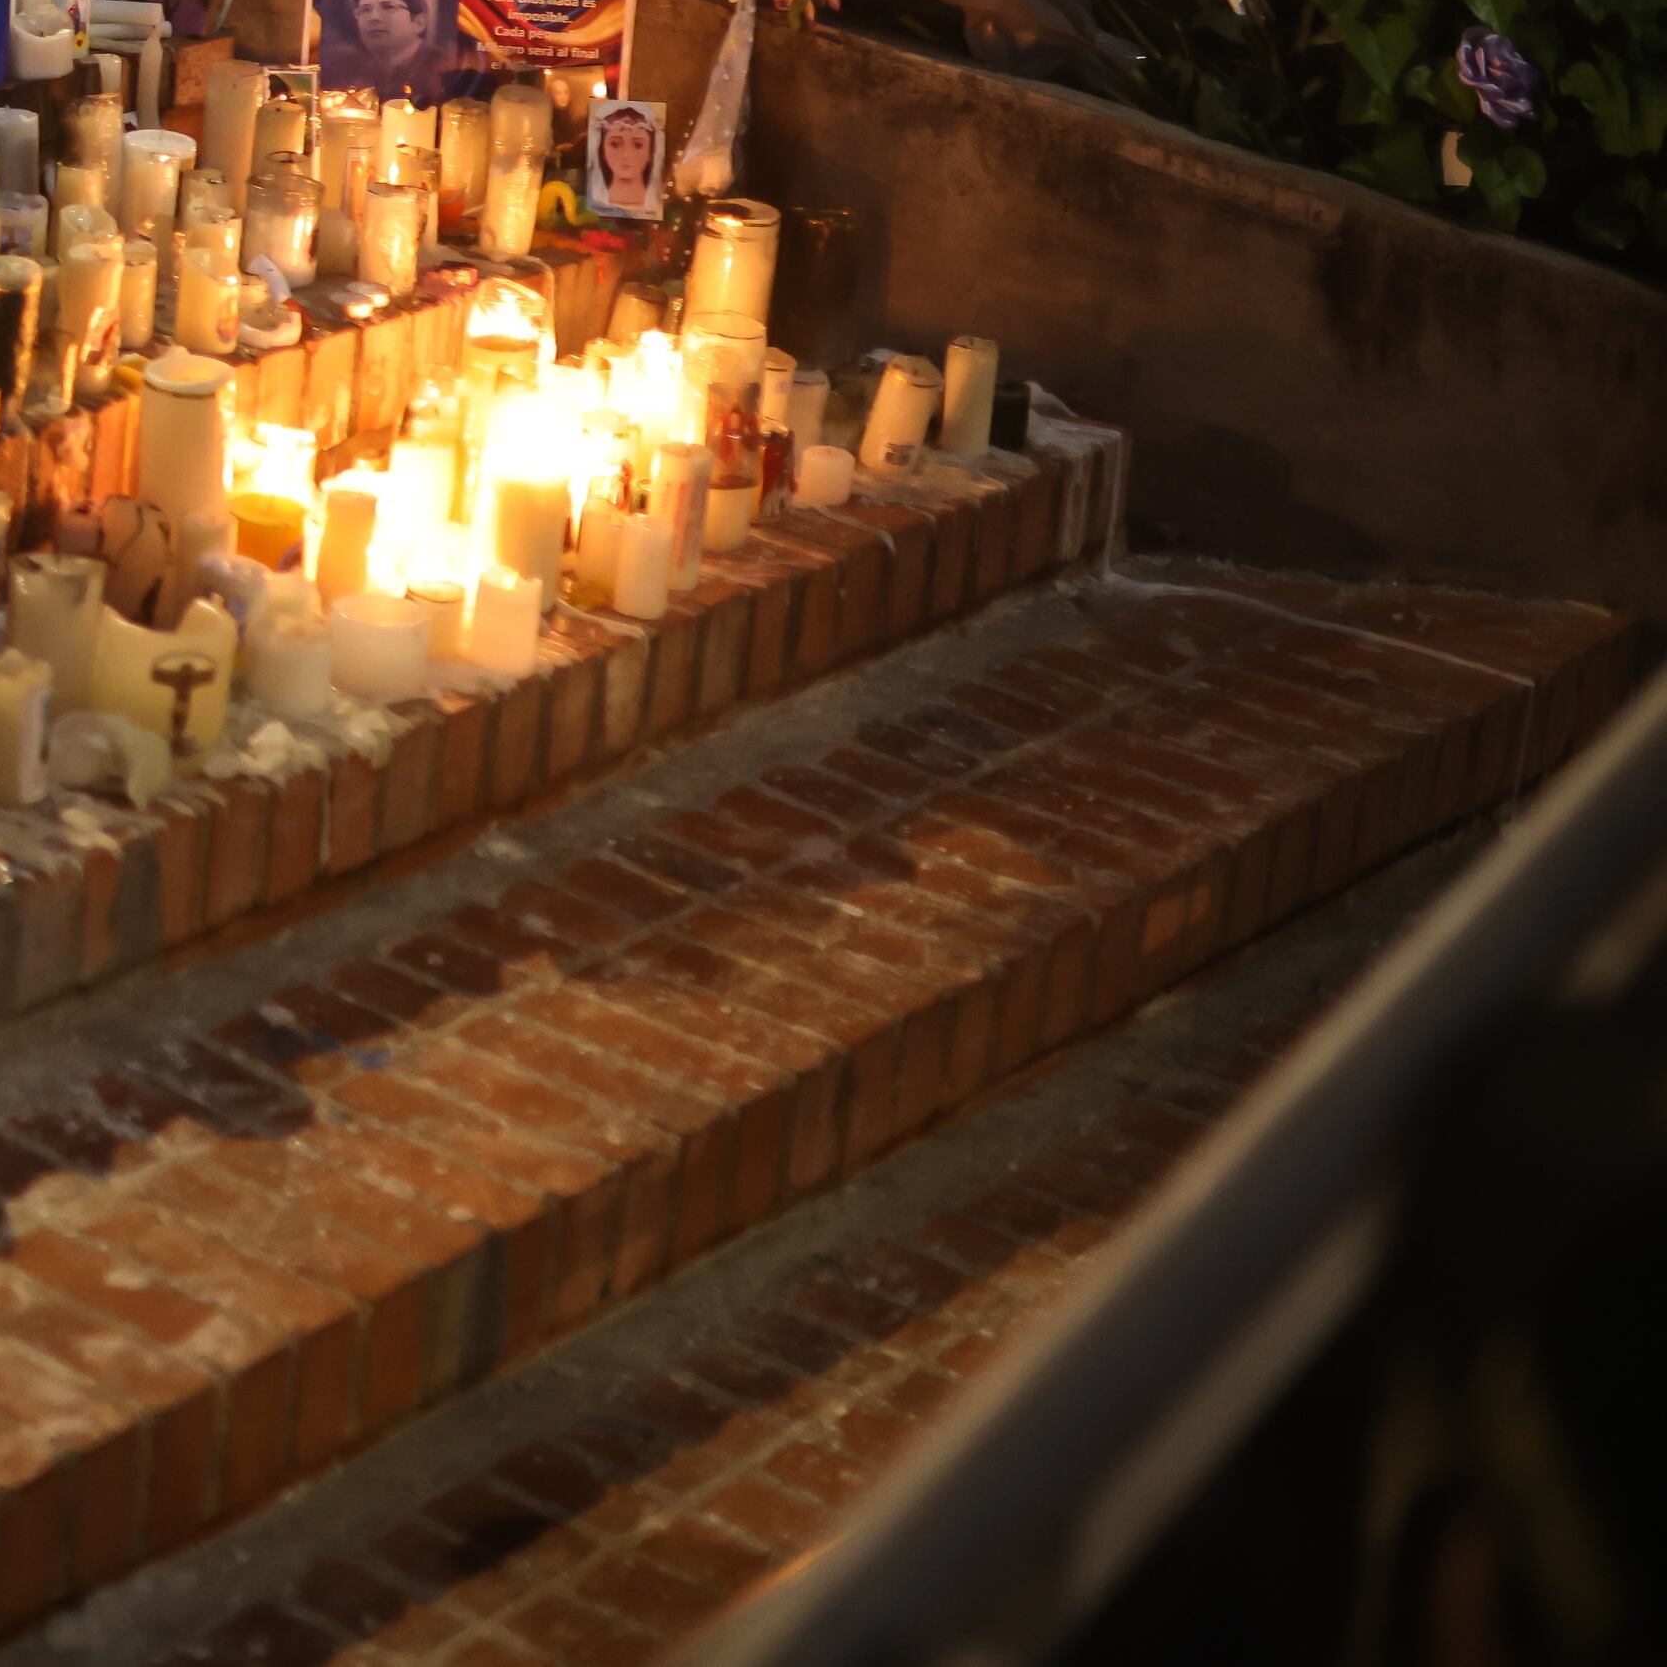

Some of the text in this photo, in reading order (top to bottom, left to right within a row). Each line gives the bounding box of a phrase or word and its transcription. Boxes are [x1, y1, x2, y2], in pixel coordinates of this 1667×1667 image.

[581, 0, 597, 9] es
[495, 26, 526, 39] Cada
[477, 42, 600, 60] Mgro será al final
